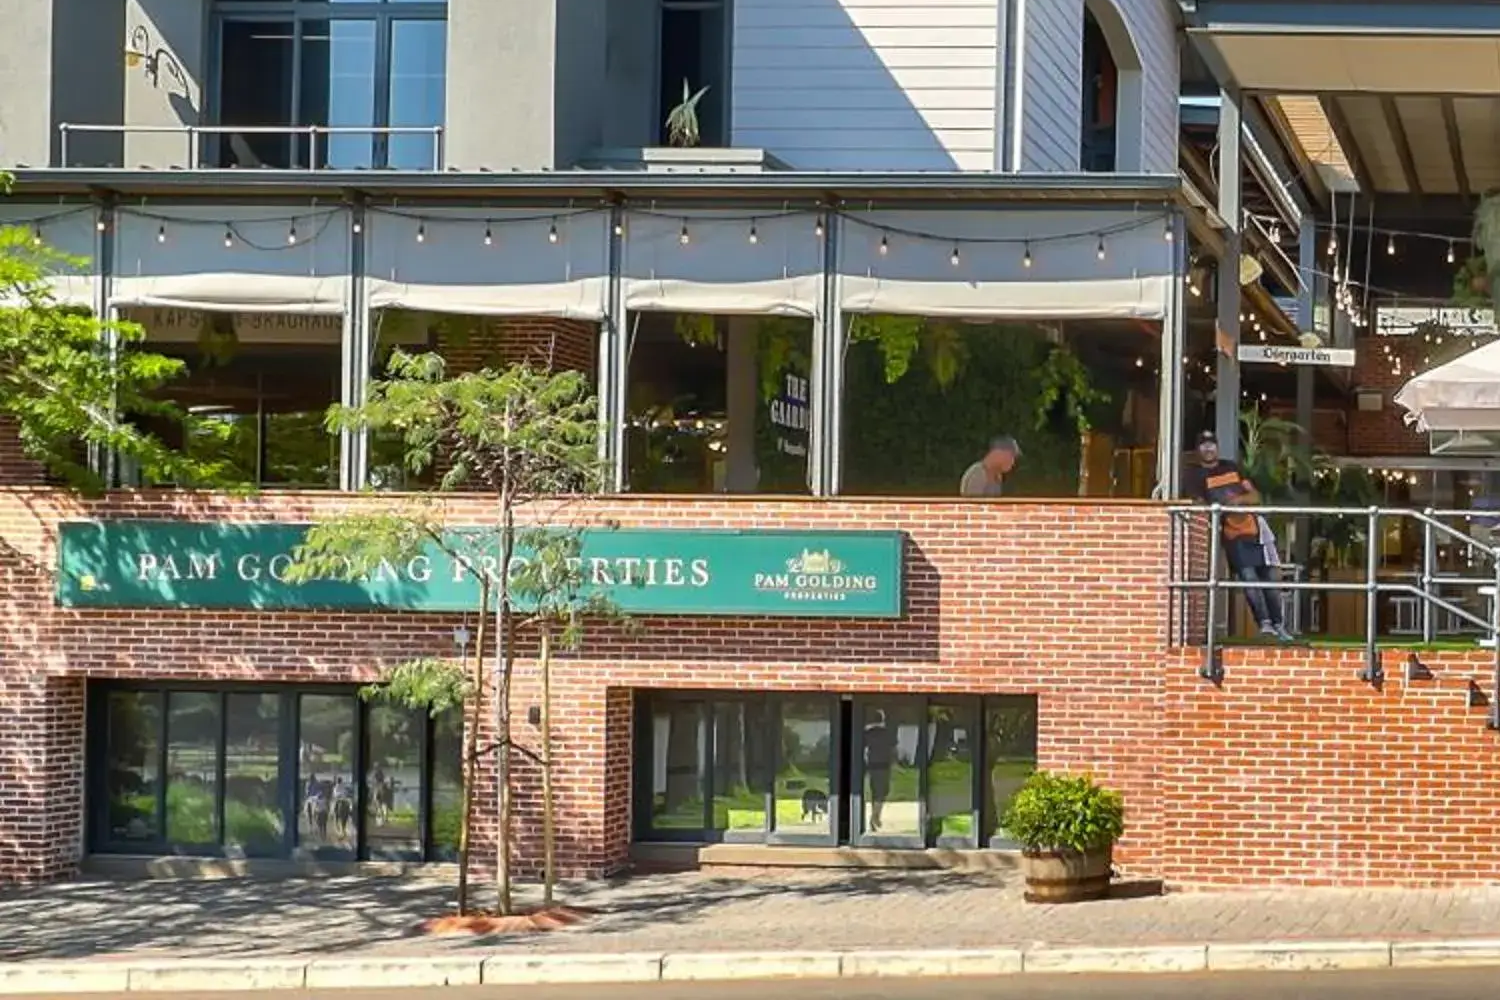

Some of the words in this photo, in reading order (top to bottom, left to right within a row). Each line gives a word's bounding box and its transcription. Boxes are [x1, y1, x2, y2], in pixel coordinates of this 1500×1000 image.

[138, 552, 218, 582] PAM
[754, 573, 789, 588] PAM
[796, 574, 878, 590] GOLDING
